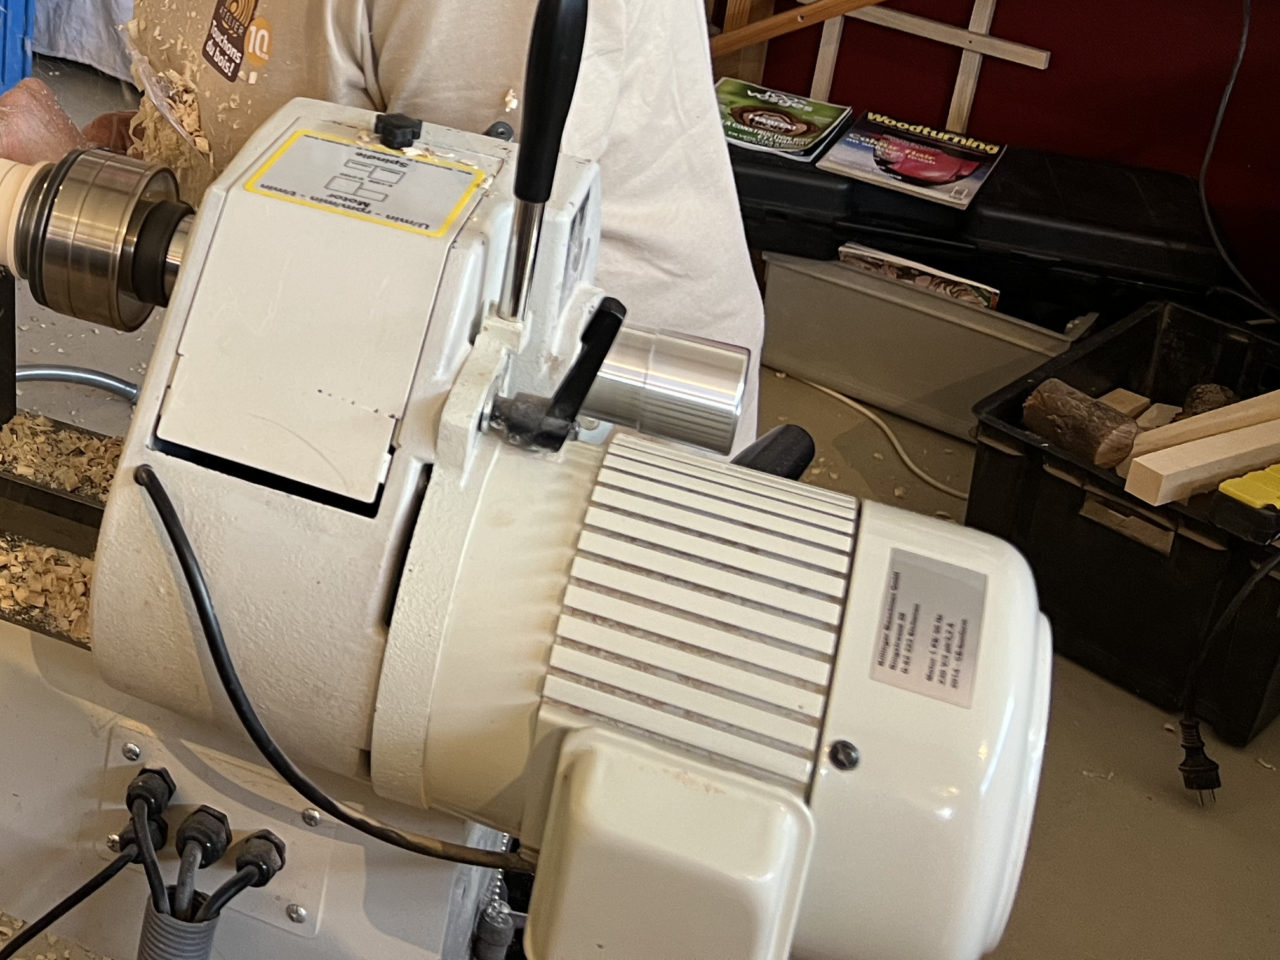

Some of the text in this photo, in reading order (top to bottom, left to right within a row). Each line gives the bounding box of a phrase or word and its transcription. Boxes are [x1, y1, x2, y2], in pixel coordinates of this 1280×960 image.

[220, 5, 245, 37] ATELIER
[210, 19, 242, 64] Touchons
[205, 39, 236, 77] du bois!
[867, 111, 1001, 155] Woodturning
[355, 151, 410, 169] Spindle
[310, 195, 372, 215] rpm/min
[326, 192, 372, 208] Motor
